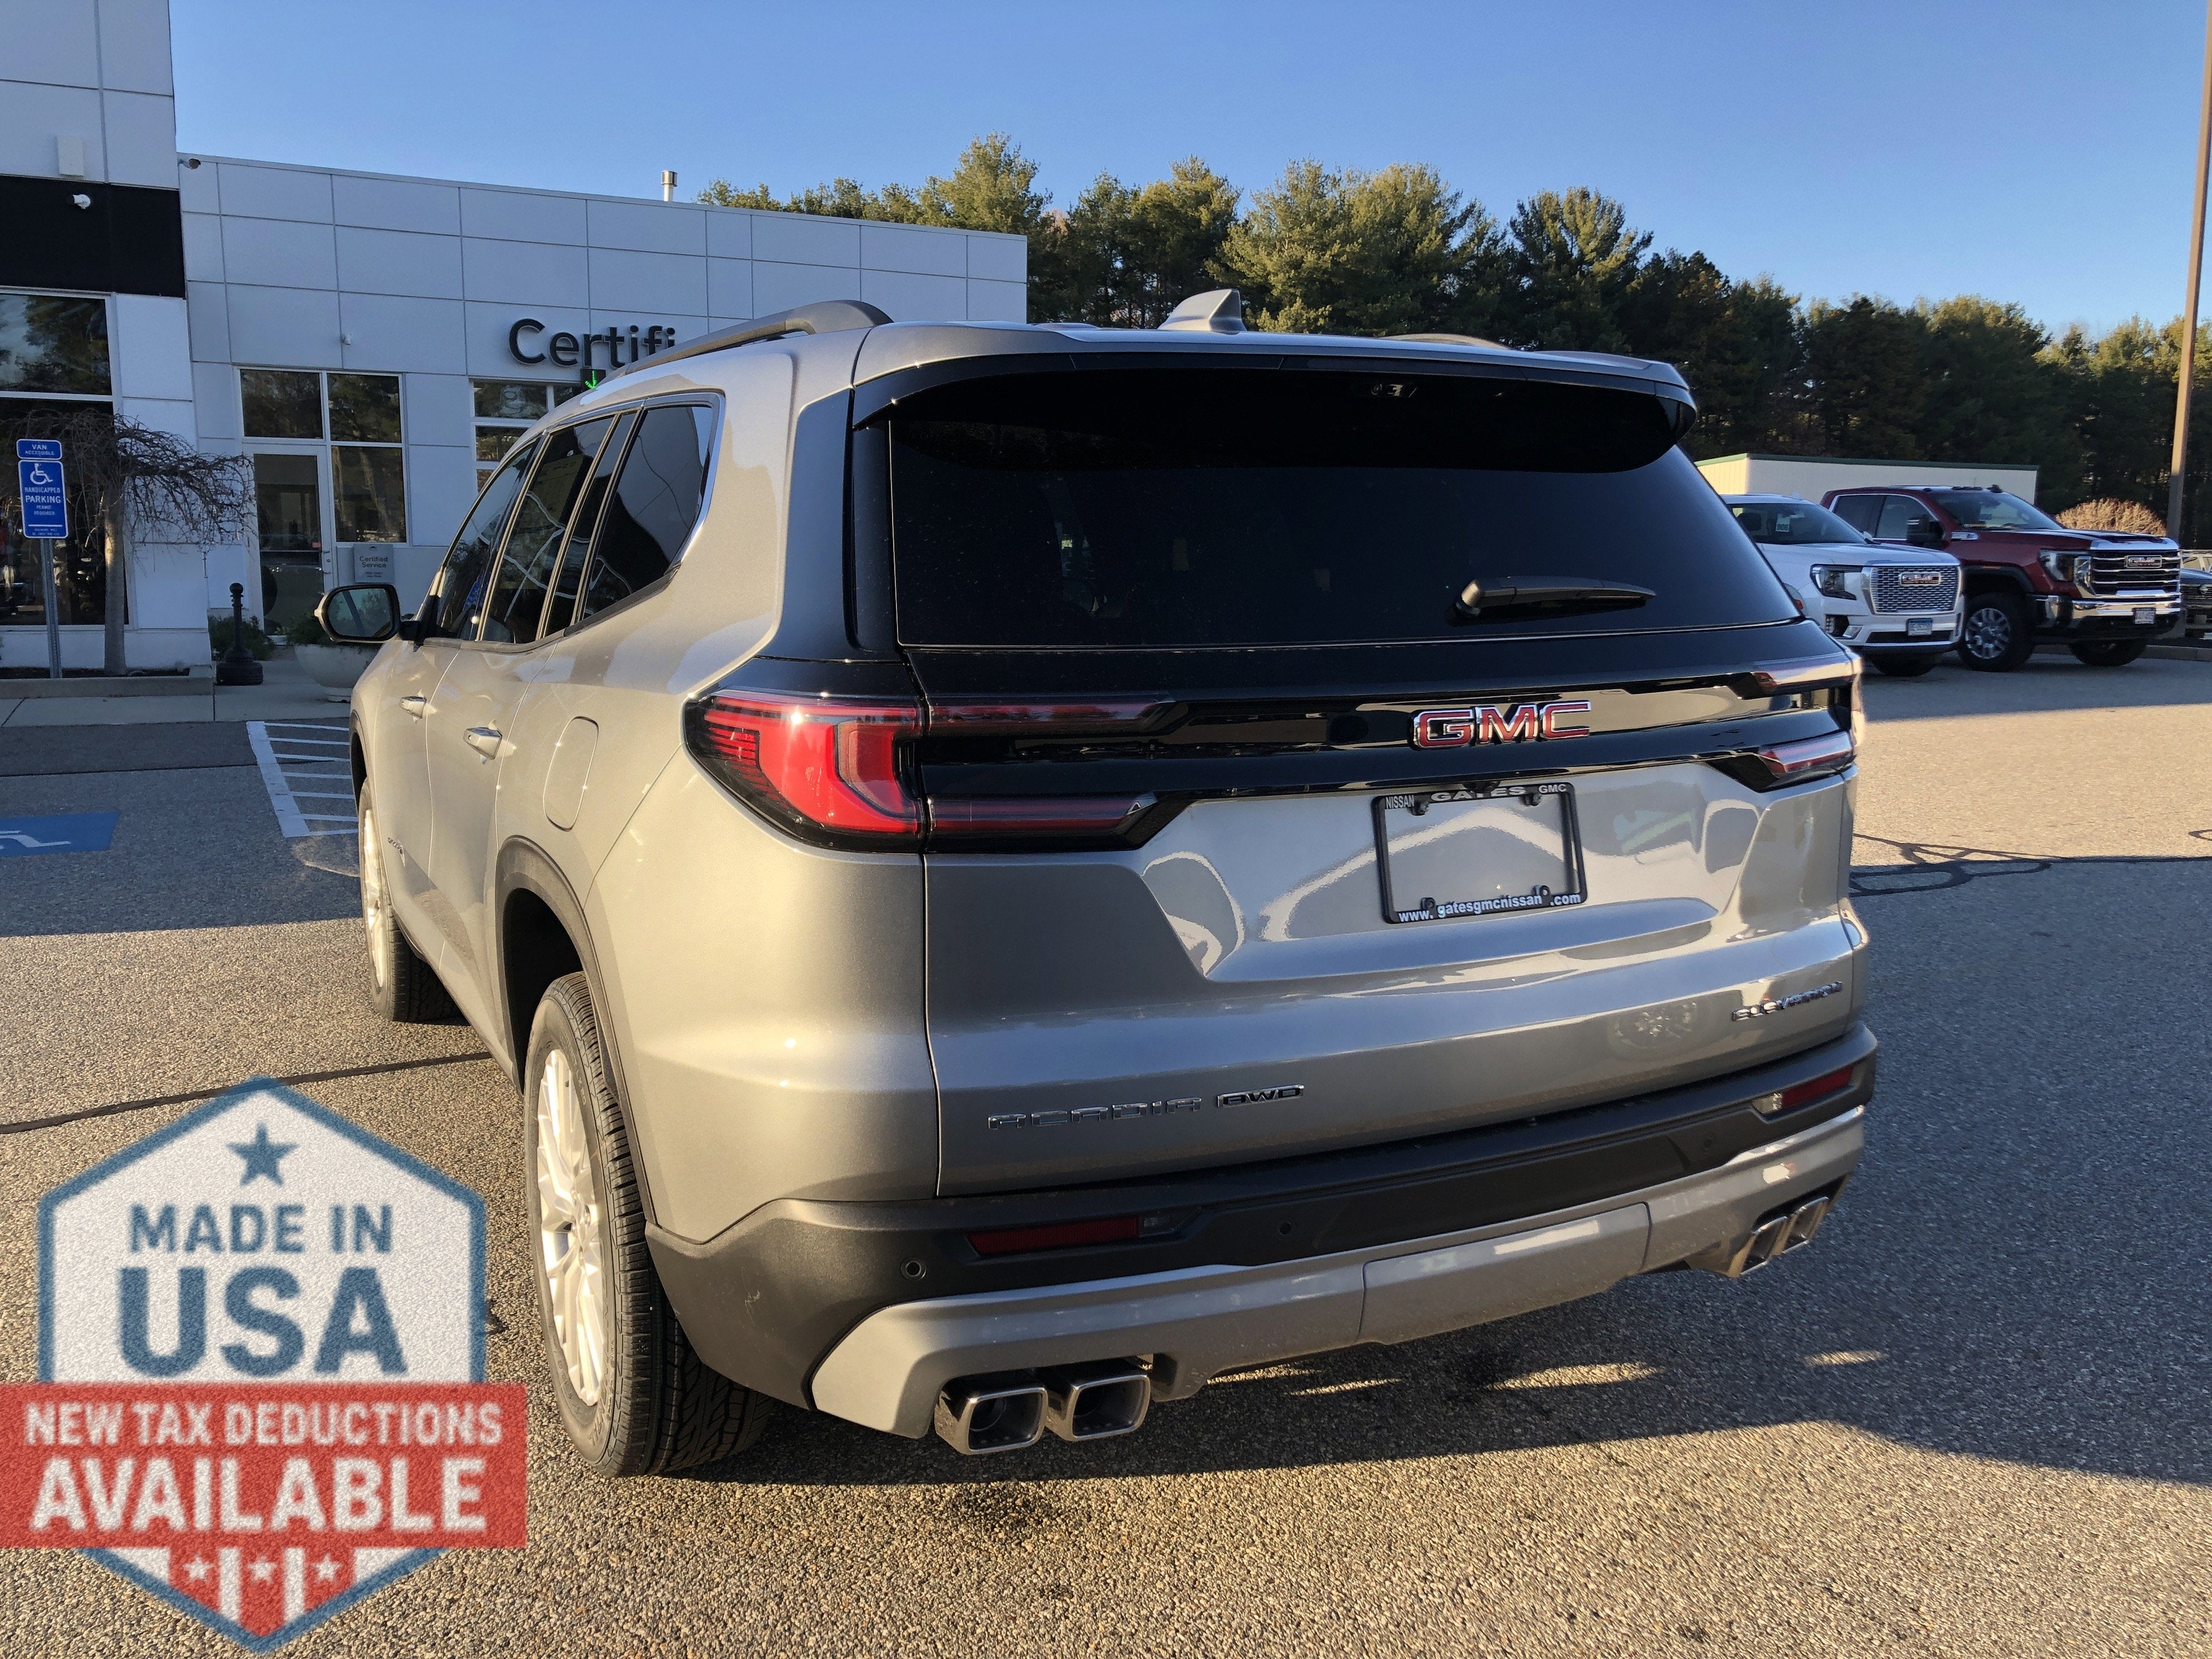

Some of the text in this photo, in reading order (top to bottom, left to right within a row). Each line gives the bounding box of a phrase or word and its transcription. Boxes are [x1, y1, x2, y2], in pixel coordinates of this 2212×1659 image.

[25, 495, 61, 504] PARKING
[1413, 700, 1591, 748] GMC
[1385, 794, 1415, 810] NISSAN
[1538, 783, 1567, 794] GMC
[1398, 893, 1581, 922] www. gatesgmcnissan .com
[988, 1084, 1305, 1130] ACADIA AWD
